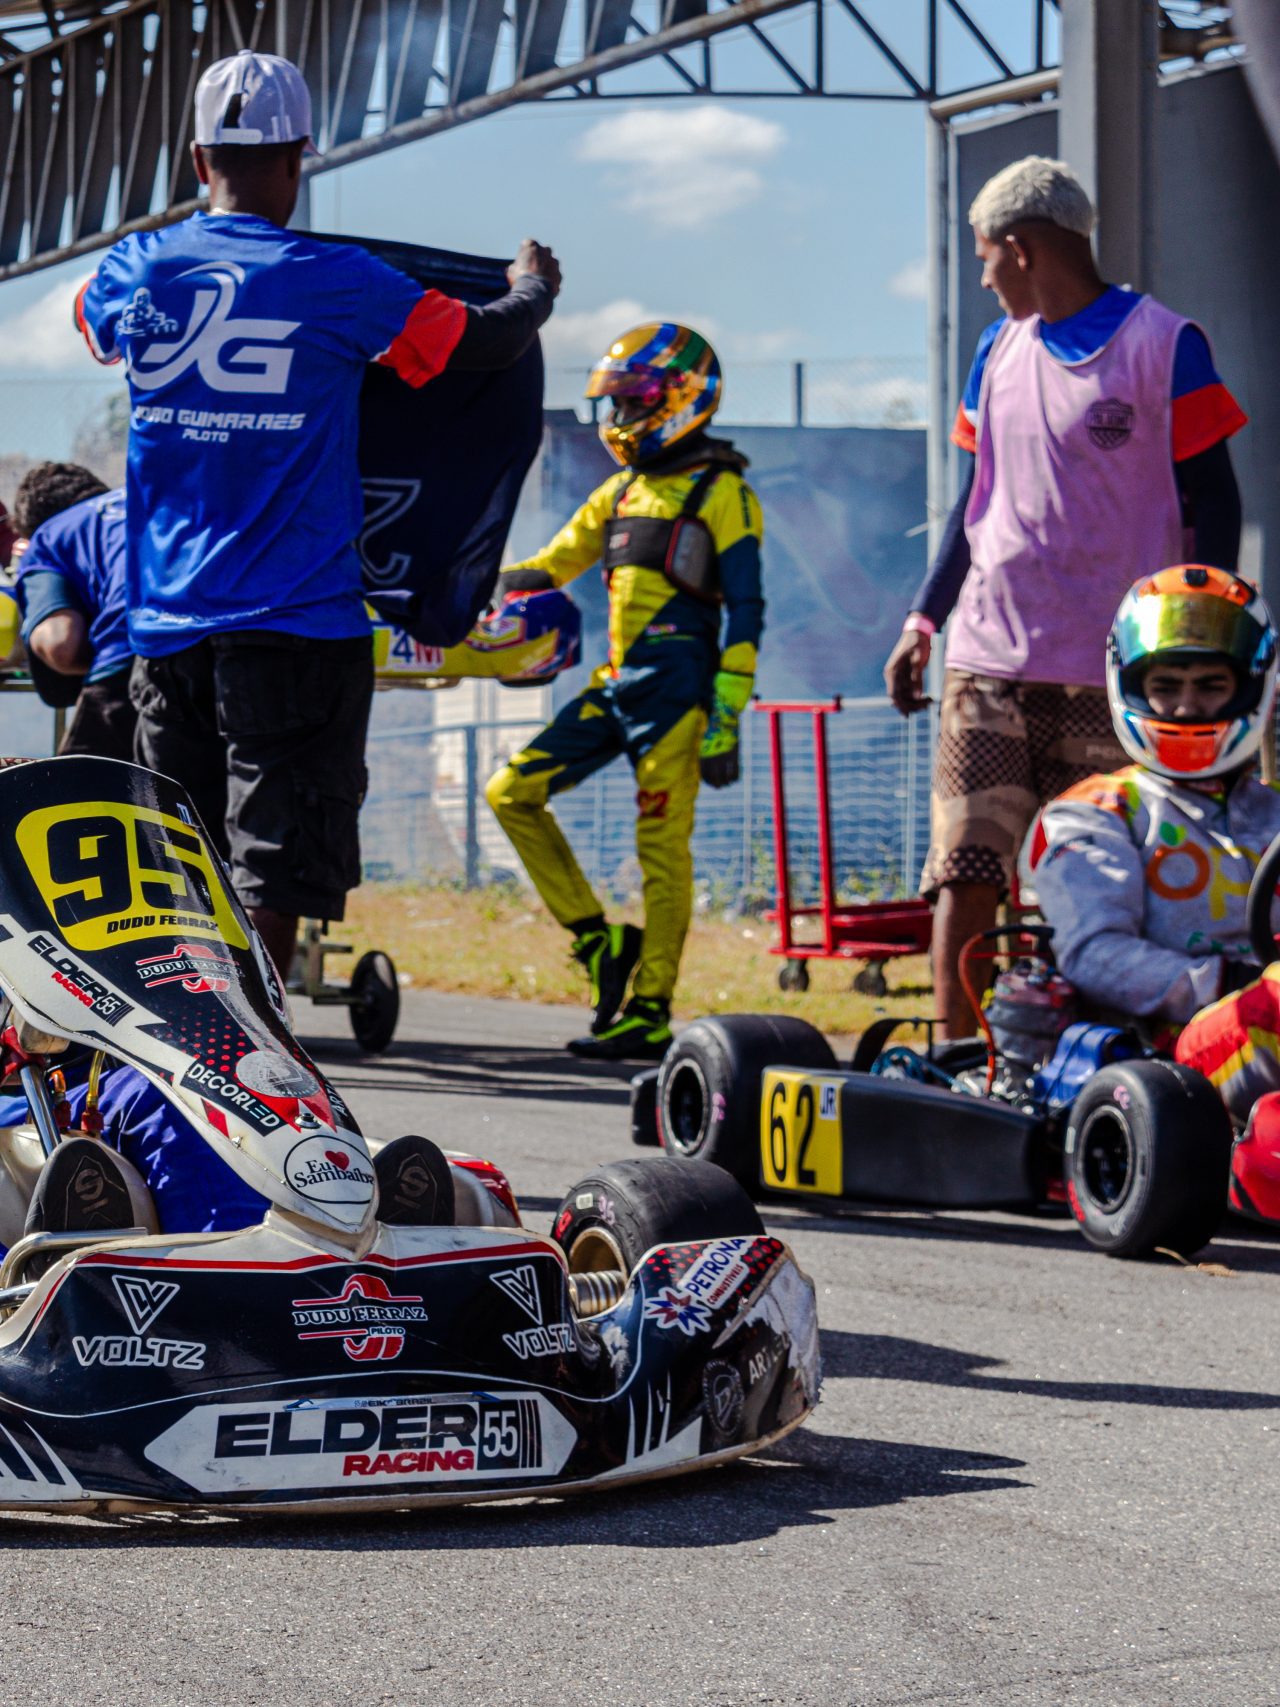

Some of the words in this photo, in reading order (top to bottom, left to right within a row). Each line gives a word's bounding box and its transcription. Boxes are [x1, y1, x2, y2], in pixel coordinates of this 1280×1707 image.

[182, 428, 230, 443] PILOTO
[46, 815, 217, 928] 95
[106, 915, 156, 935] DUDU
[159, 914, 219, 932] FERRAZ
[27, 934, 109, 1002] ELDER
[96, 996, 121, 1015] 55
[136, 960, 187, 980] DUDU
[51, 971, 95, 1008] RACING
[188, 1063, 281, 1129] DECORLED
[770, 1081, 817, 1187] 62
[305, 1159, 332, 1174] Eu
[292, 1309, 350, 1326] DUDU
[353, 1305, 429, 1321] FERRAZ
[370, 1327, 405, 1335] PILOTO
[73, 1336, 207, 1370] VOLTZ
[503, 1322, 577, 1360] VOLTZ
[214, 1404, 478, 1459] ELDER
[482, 1410, 518, 1457] 55
[342, 1449, 475, 1477] RACING
